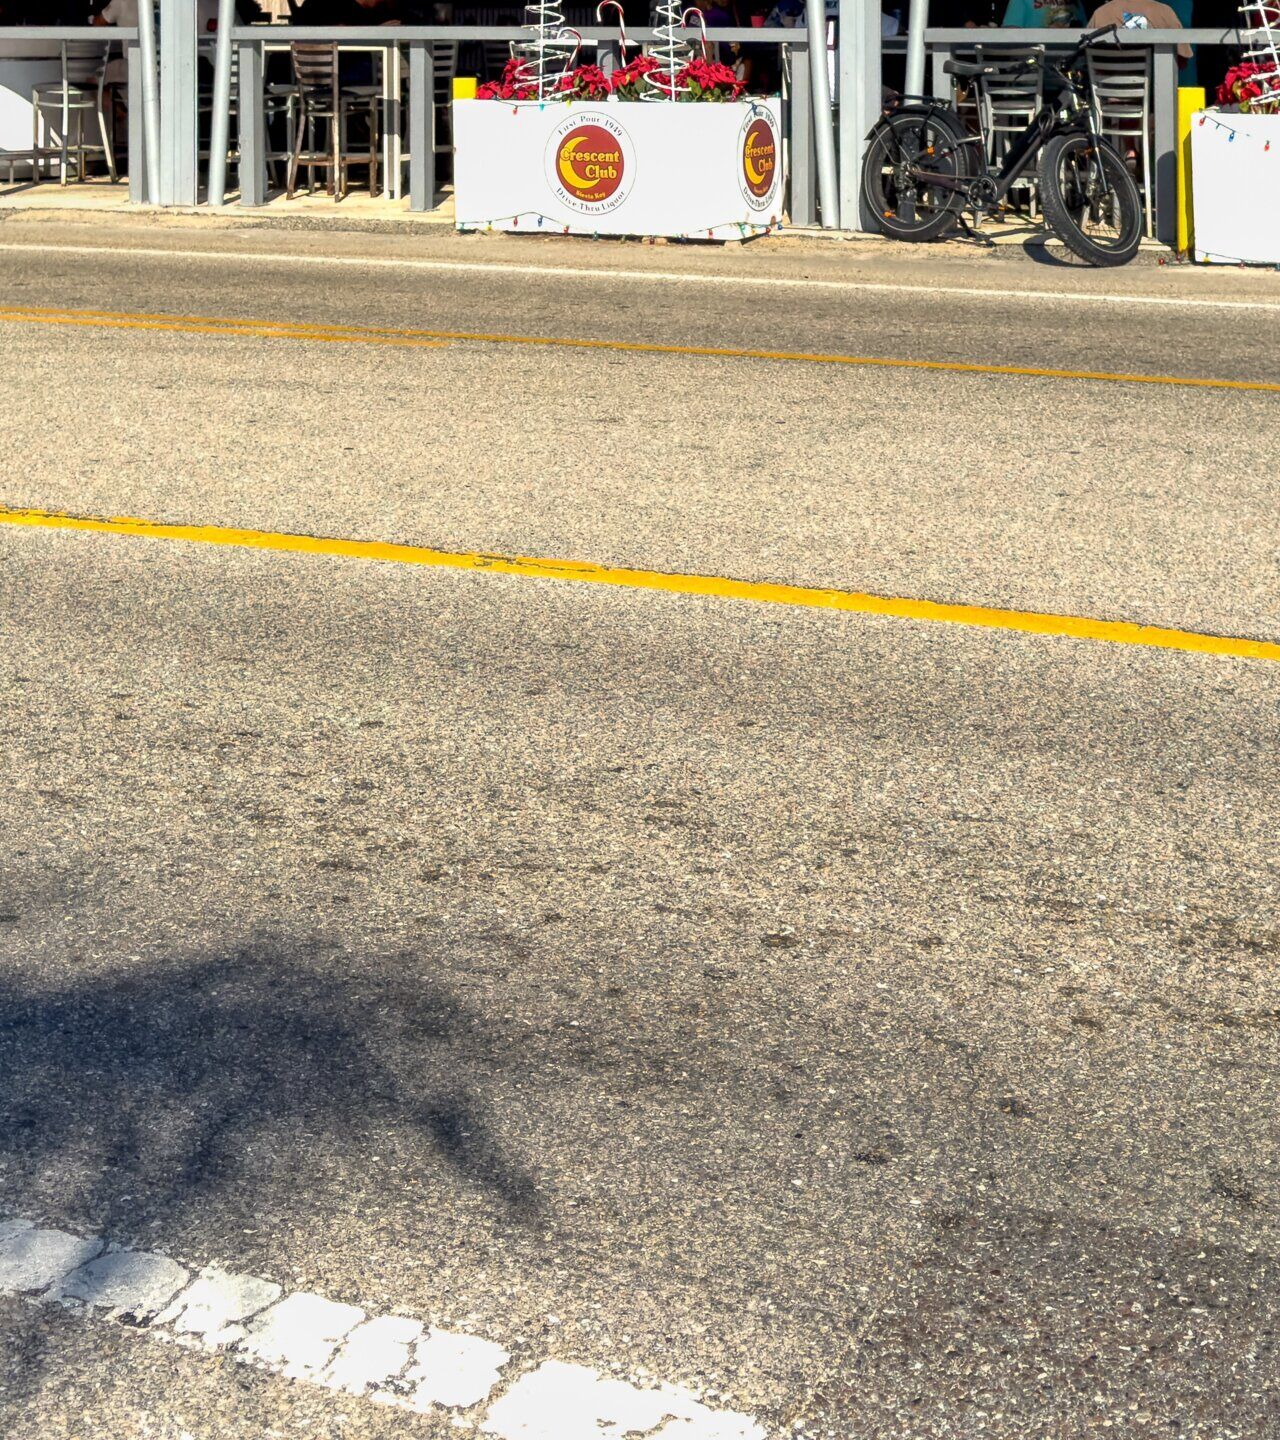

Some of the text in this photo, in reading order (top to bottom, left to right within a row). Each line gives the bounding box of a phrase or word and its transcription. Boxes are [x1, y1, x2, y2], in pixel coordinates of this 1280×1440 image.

[605, 120, 623, 136] 1949
[560, 147, 620, 163] Crescent
[745, 143, 774, 158] Crescent
[585, 164, 618, 179] Club
[758, 158, 773, 172] Club
[602, 190, 625, 210] Liquor
